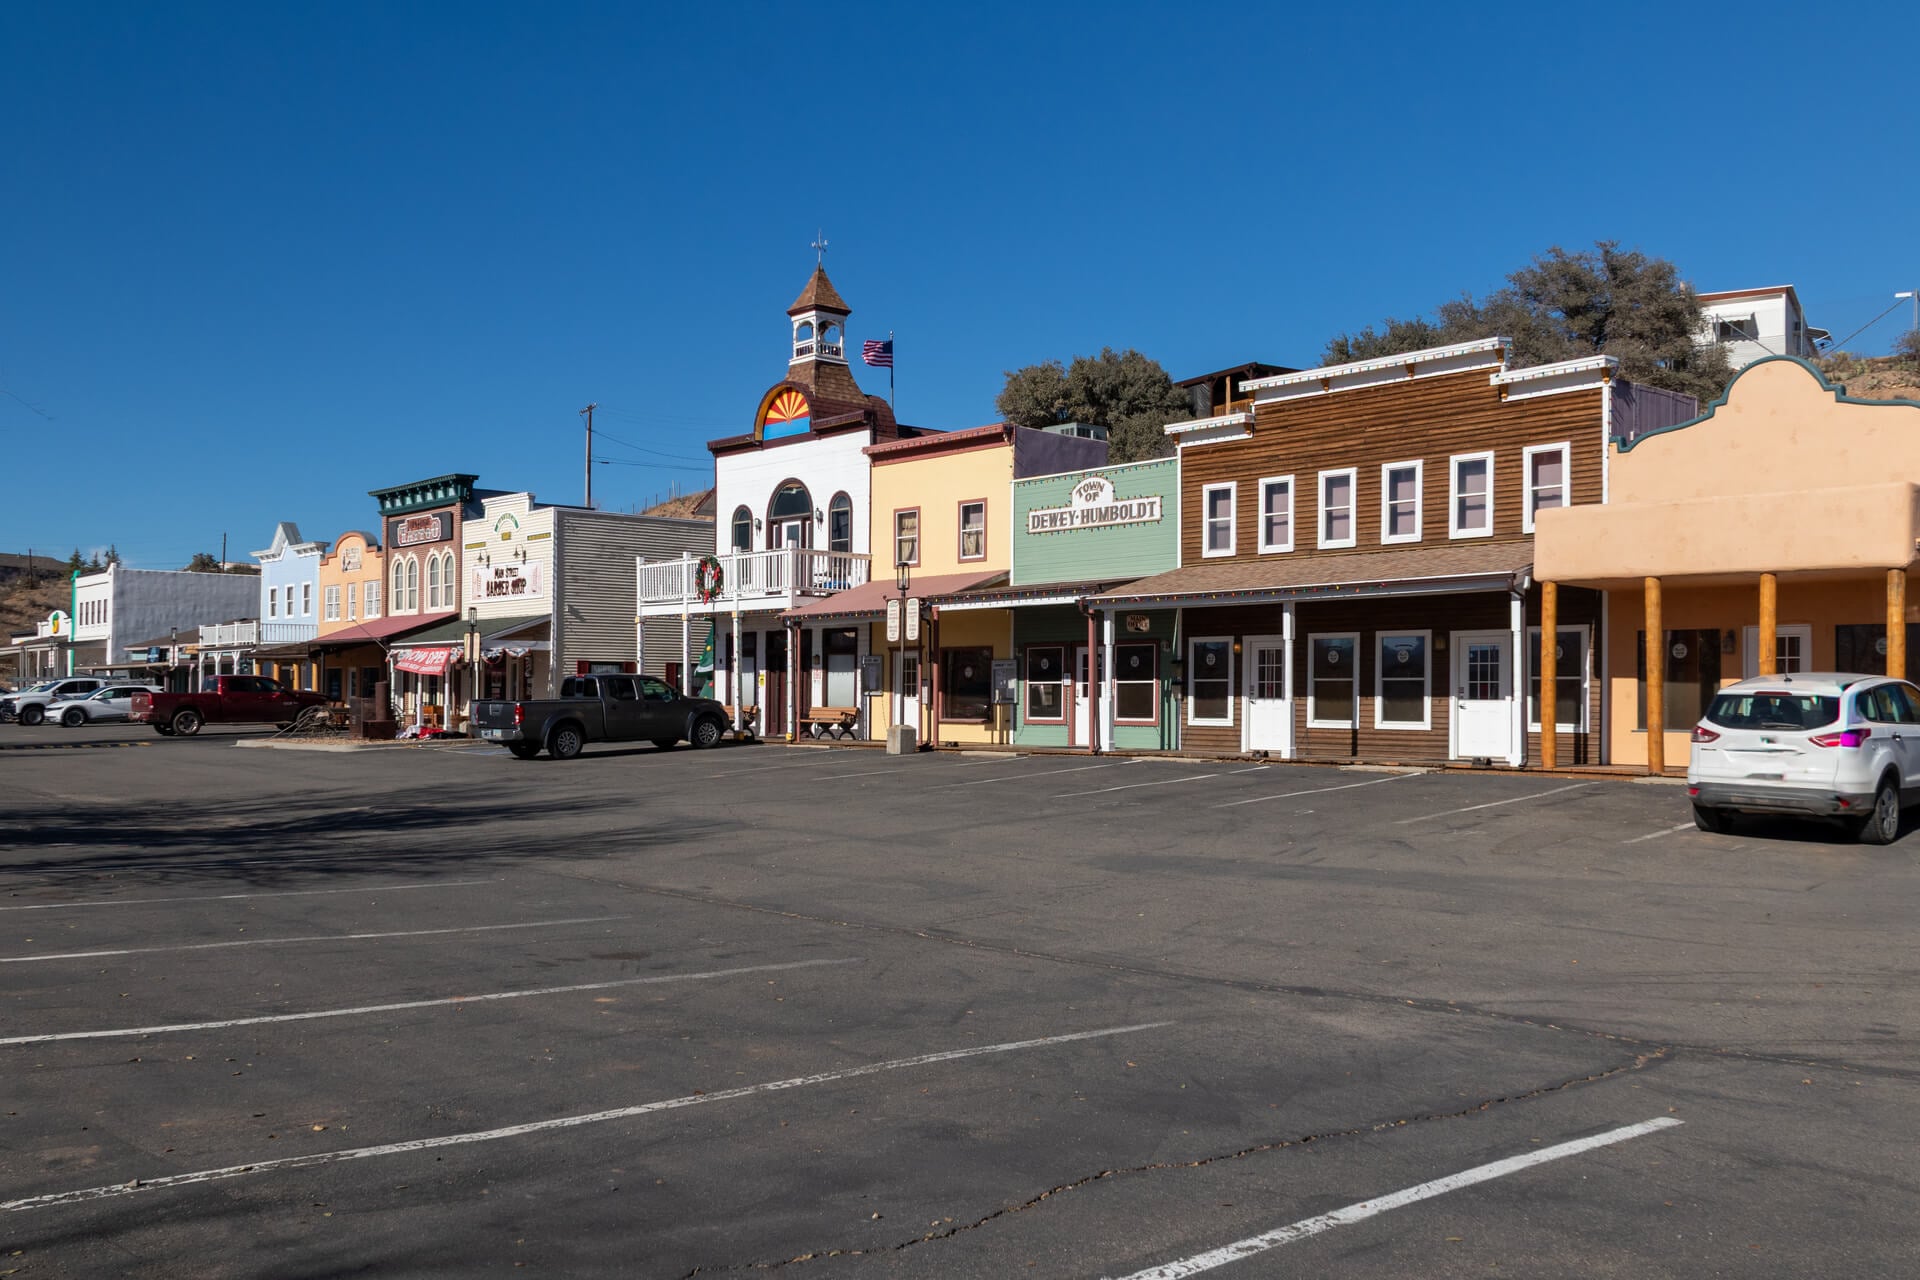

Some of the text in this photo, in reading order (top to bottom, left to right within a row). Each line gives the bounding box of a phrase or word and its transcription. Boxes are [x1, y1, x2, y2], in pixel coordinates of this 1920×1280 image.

[1075, 481, 1105, 498] TOWN
[1084, 491, 1100, 503] OF
[511, 577, 527, 594] SHOP
